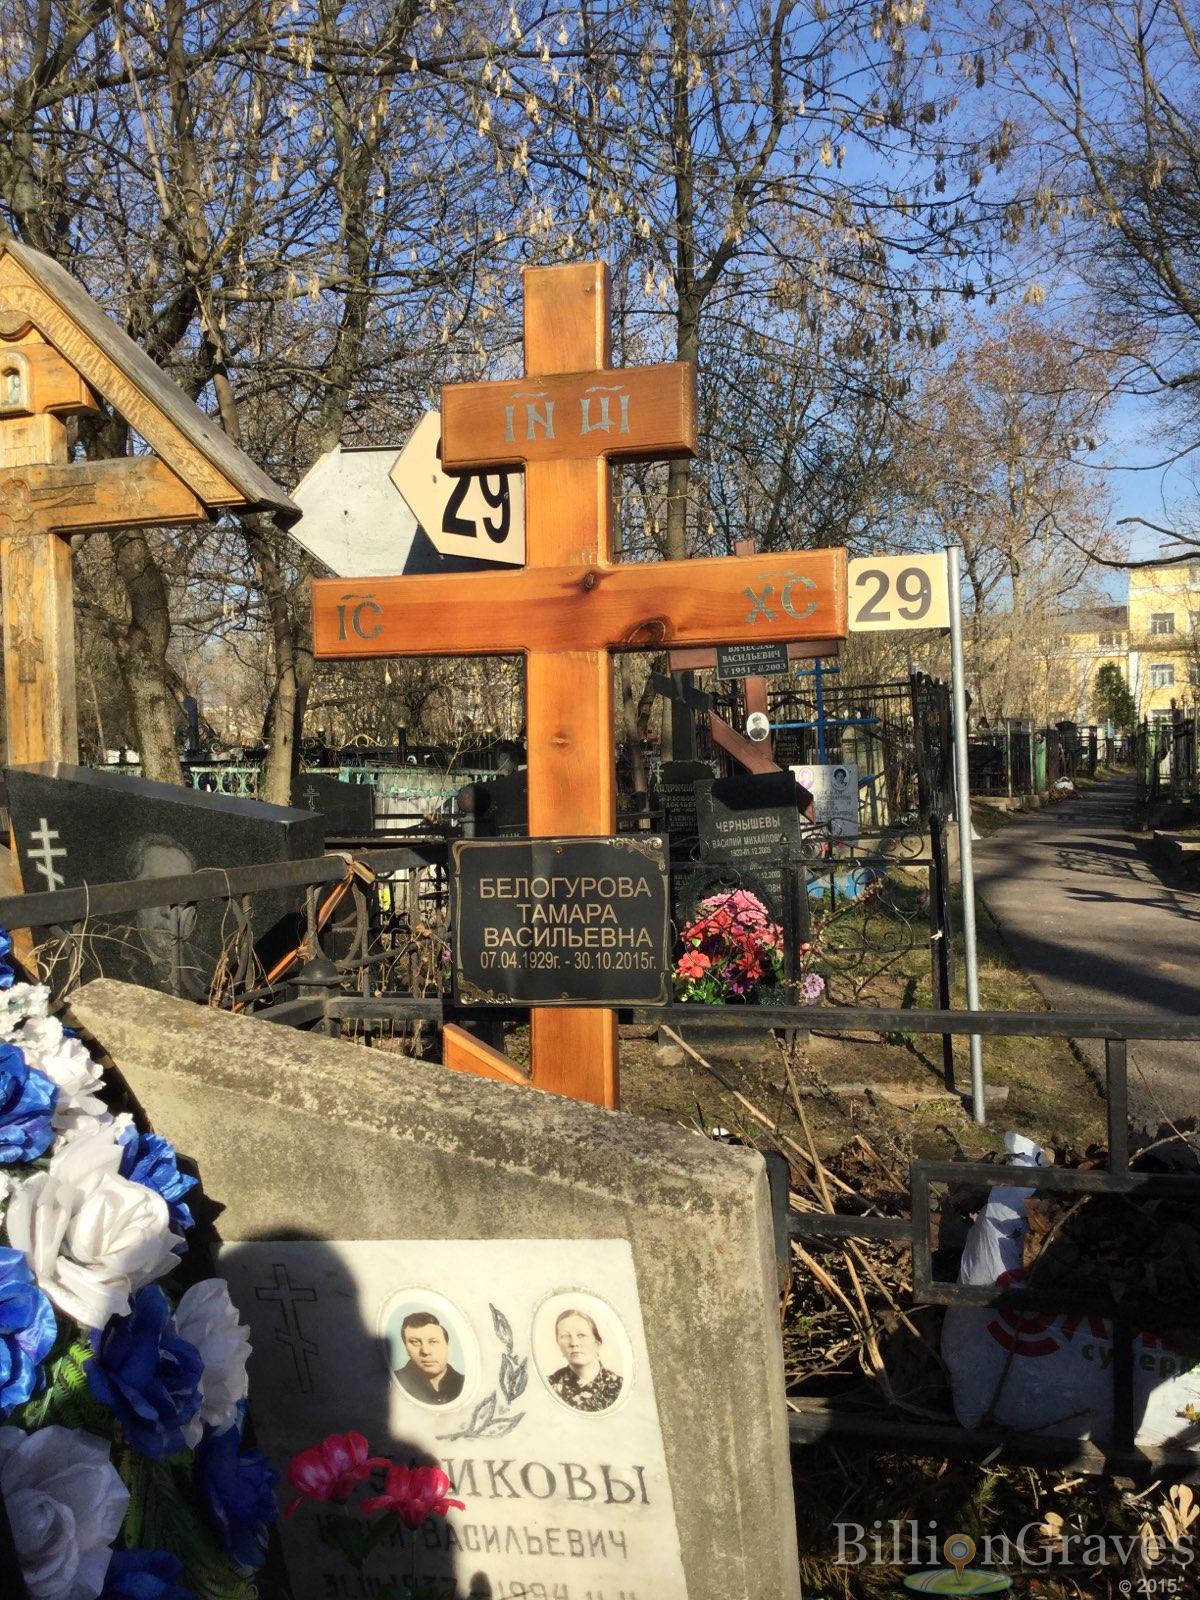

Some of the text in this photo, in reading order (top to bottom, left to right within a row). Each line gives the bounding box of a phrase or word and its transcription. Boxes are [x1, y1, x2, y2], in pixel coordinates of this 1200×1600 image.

[436, 437, 510, 543] 29
[855, 567, 931, 622] 29
[722, 650, 781, 663] ВАСИЛЬЕВИЧ
[715, 815, 781, 833] ЧЕРНЫШЕВЫ
[479, 877, 652, 899] БЕЛОГУРОВА
[516, 903, 618, 924] ТАМАРА
[484, 927, 653, 948] ВАСИЛЬЕВНА
[480, 951, 561, 969] 07.04.1929г.
[574, 951, 657, 970] 30.10.2015г.
[421, 1517, 628, 1559] ВАСИЛЬЕВИЧ
